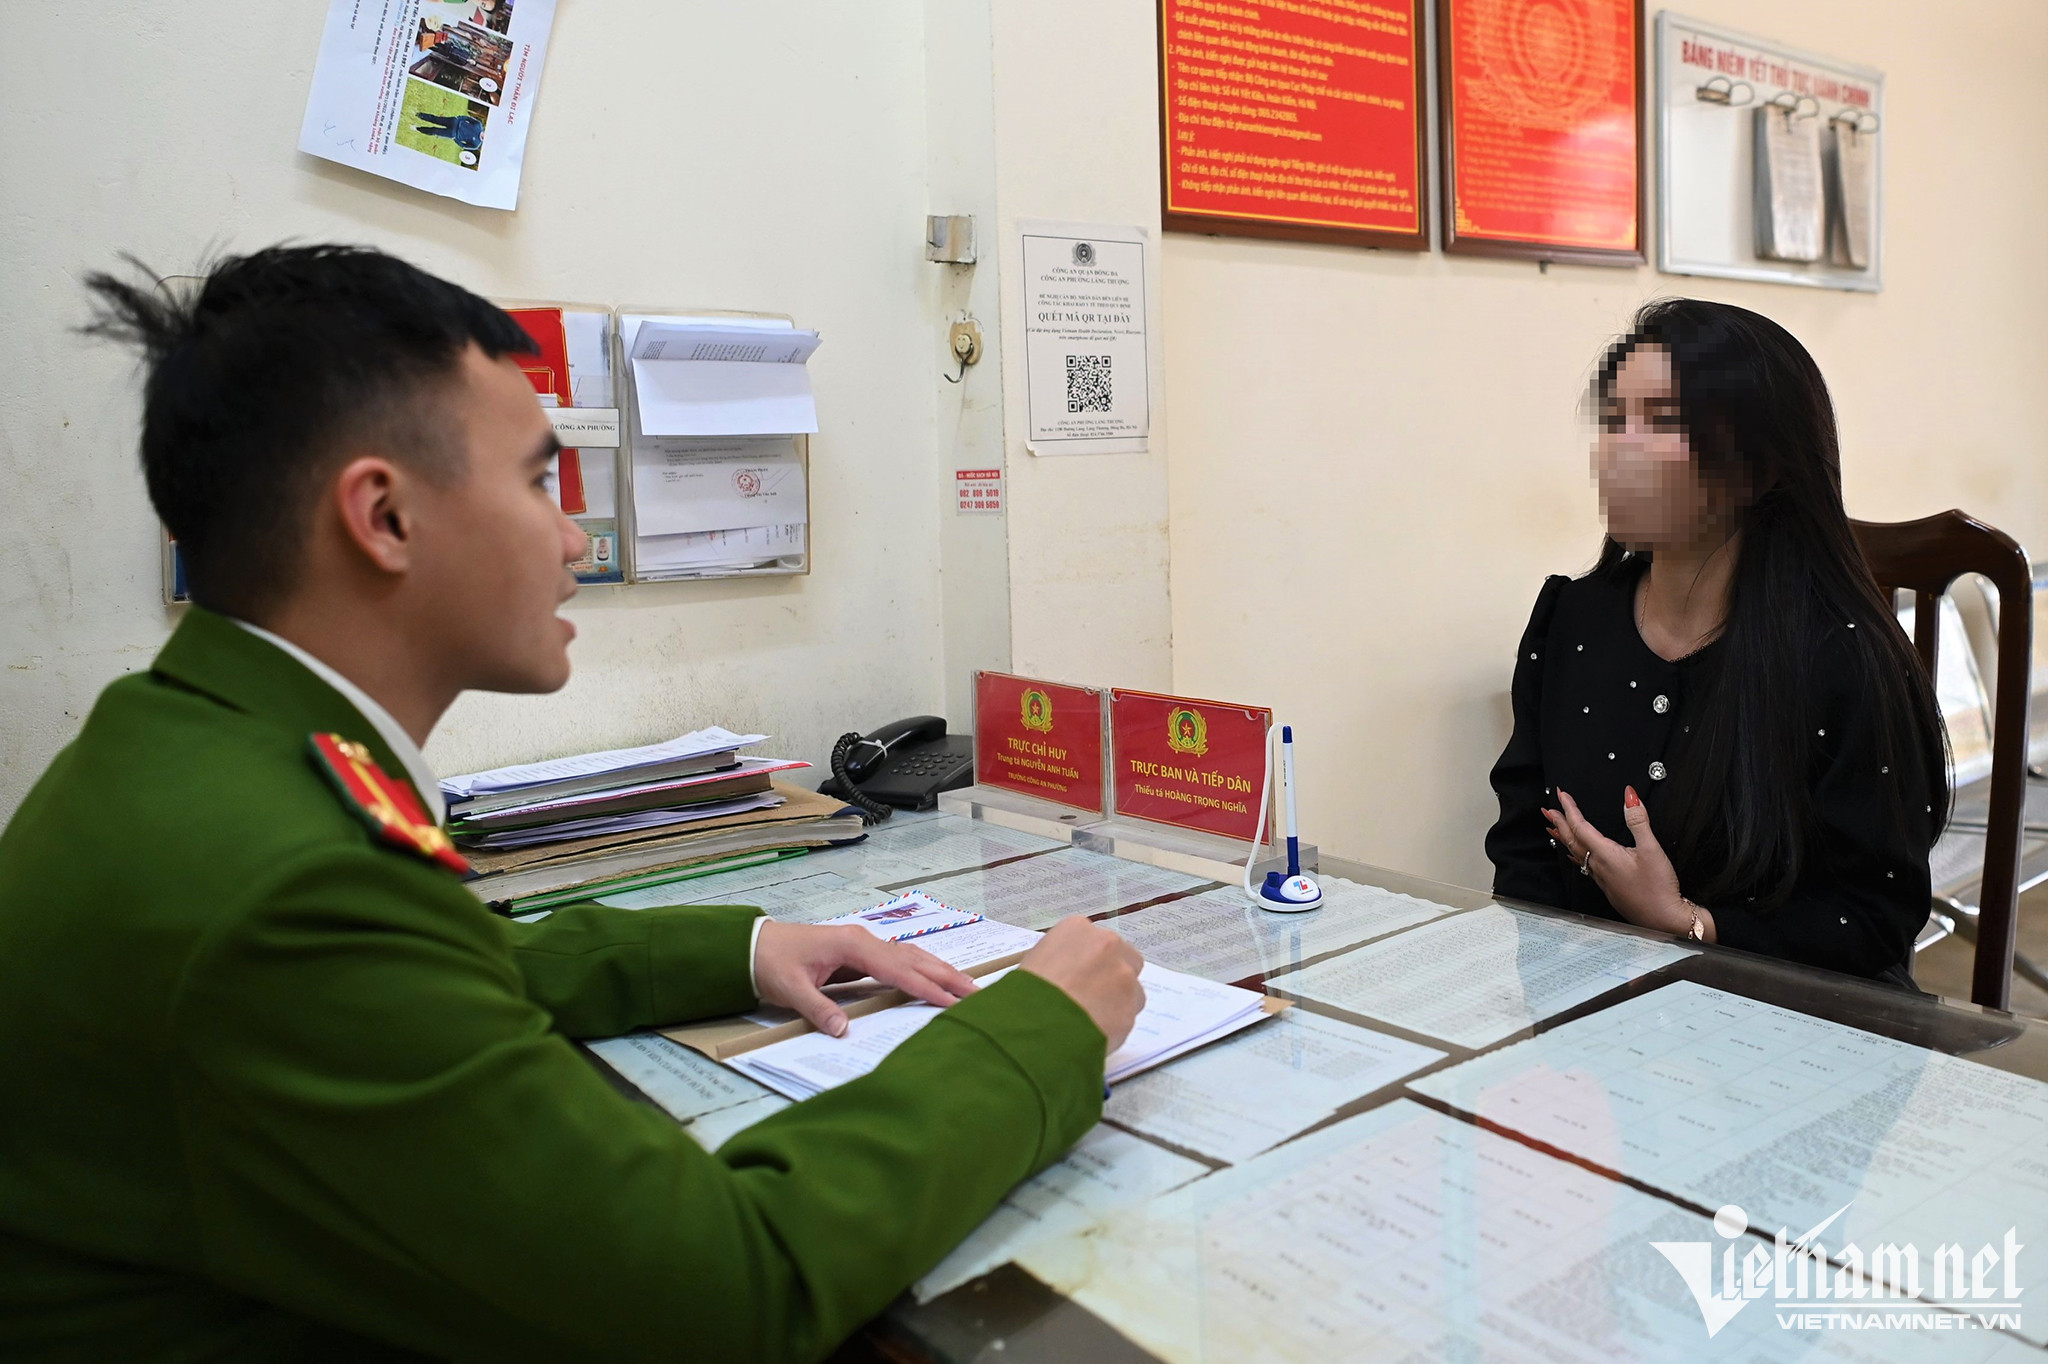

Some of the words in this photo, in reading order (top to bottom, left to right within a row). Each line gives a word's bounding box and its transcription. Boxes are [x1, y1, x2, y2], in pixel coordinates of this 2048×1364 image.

[522, 43, 531, 57] TÌM
[517, 57, 527, 81] NGƯỜI
[512, 82, 521, 101] THÂN
[510, 101, 516, 110] ĐI
[1038, 310, 1063, 322] QUÉT
[1066, 312, 1080, 322] MÃ
[1082, 314, 1095, 324] QR
[1097, 314, 1112, 324] TẠI
[1114, 312, 1131, 323] ĐÂY
[1008, 737, 1030, 754] TRỰC
[1032, 740, 1047, 755] CHỈ
[1048, 747, 1067, 761] HUY
[997, 752, 1014, 766] Trung
[1014, 755, 1020, 766] tá
[1021, 756, 1045, 773] NGUYỄN
[1047, 763, 1061, 775] ANH
[1061, 764, 1079, 779] TUẤN
[1131, 760, 1159, 777] TRỰC
[1161, 766, 1182, 779] BAN
[1184, 767, 1200, 783] VÀ
[1202, 770, 1225, 788] TIẾP
[1227, 776, 1251, 793] DÂN
[1008, 770, 1026, 782] TRƯỞNG
[1027, 775, 1041, 787] CÔNG
[1047, 780, 1067, 792] PHƯỜNG
[1135, 783, 1154, 797] Thiếu
[1156, 788, 1163, 797] tá
[1165, 788, 1192, 803] HOÀNG
[1194, 795, 1220, 810] TRỌNG
[1222, 799, 1247, 814] NGHĨA
